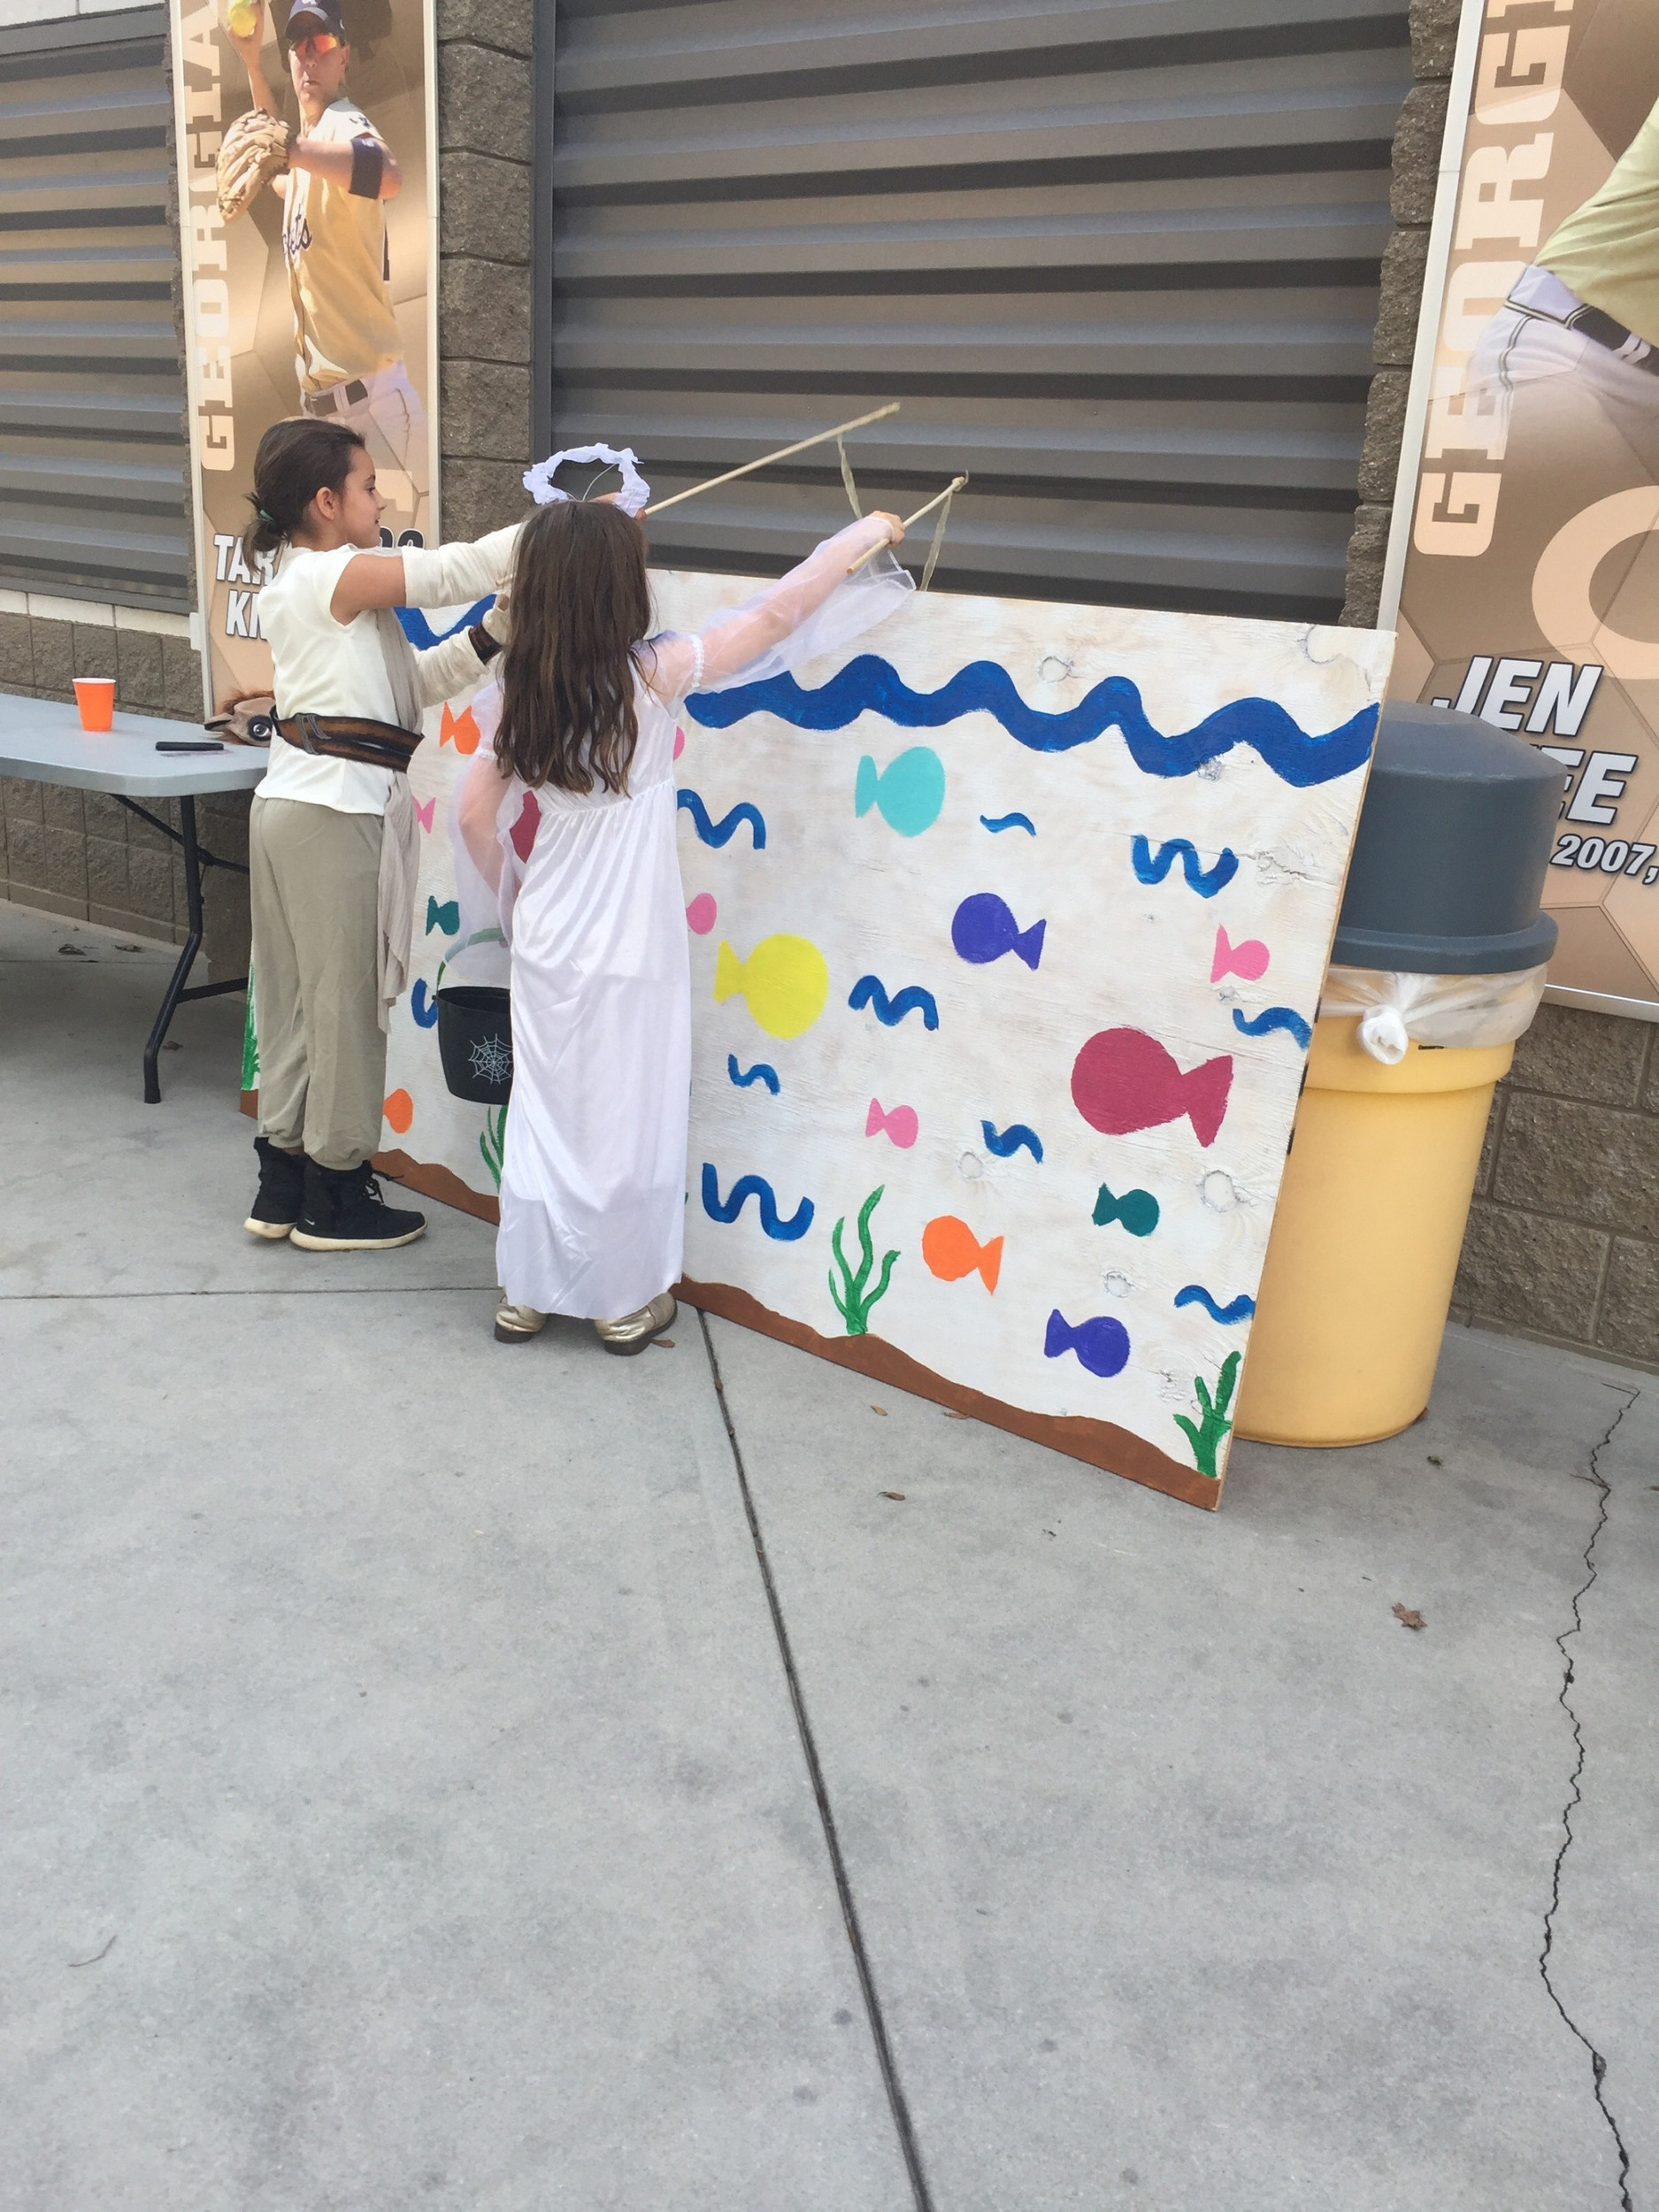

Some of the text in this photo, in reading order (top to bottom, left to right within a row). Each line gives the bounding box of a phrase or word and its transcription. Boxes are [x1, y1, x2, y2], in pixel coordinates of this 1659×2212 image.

[181, 0, 234, 472] GEORGIA
[213, 534, 289, 586] TAR
[1431, 655, 1604, 738] JEN
[1549, 833, 1659, 885] 2007,
